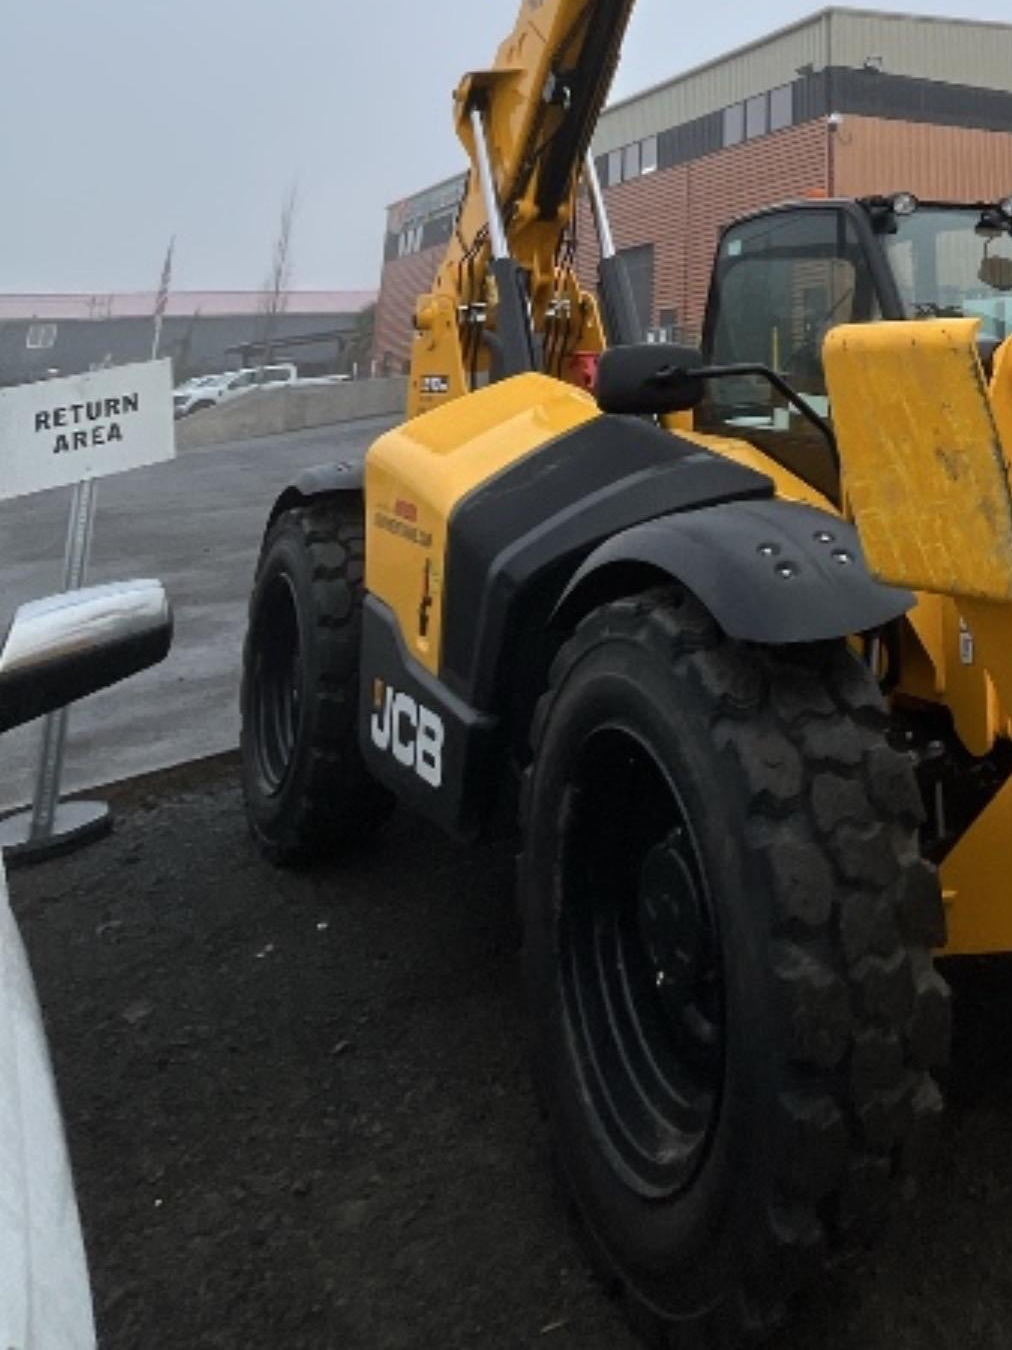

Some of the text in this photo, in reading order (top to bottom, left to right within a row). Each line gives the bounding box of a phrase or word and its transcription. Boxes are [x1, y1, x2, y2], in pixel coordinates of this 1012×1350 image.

[34, 392, 139, 432] RETURN
[53, 423, 123, 454] AREA
[370, 682, 445, 788] JCB
